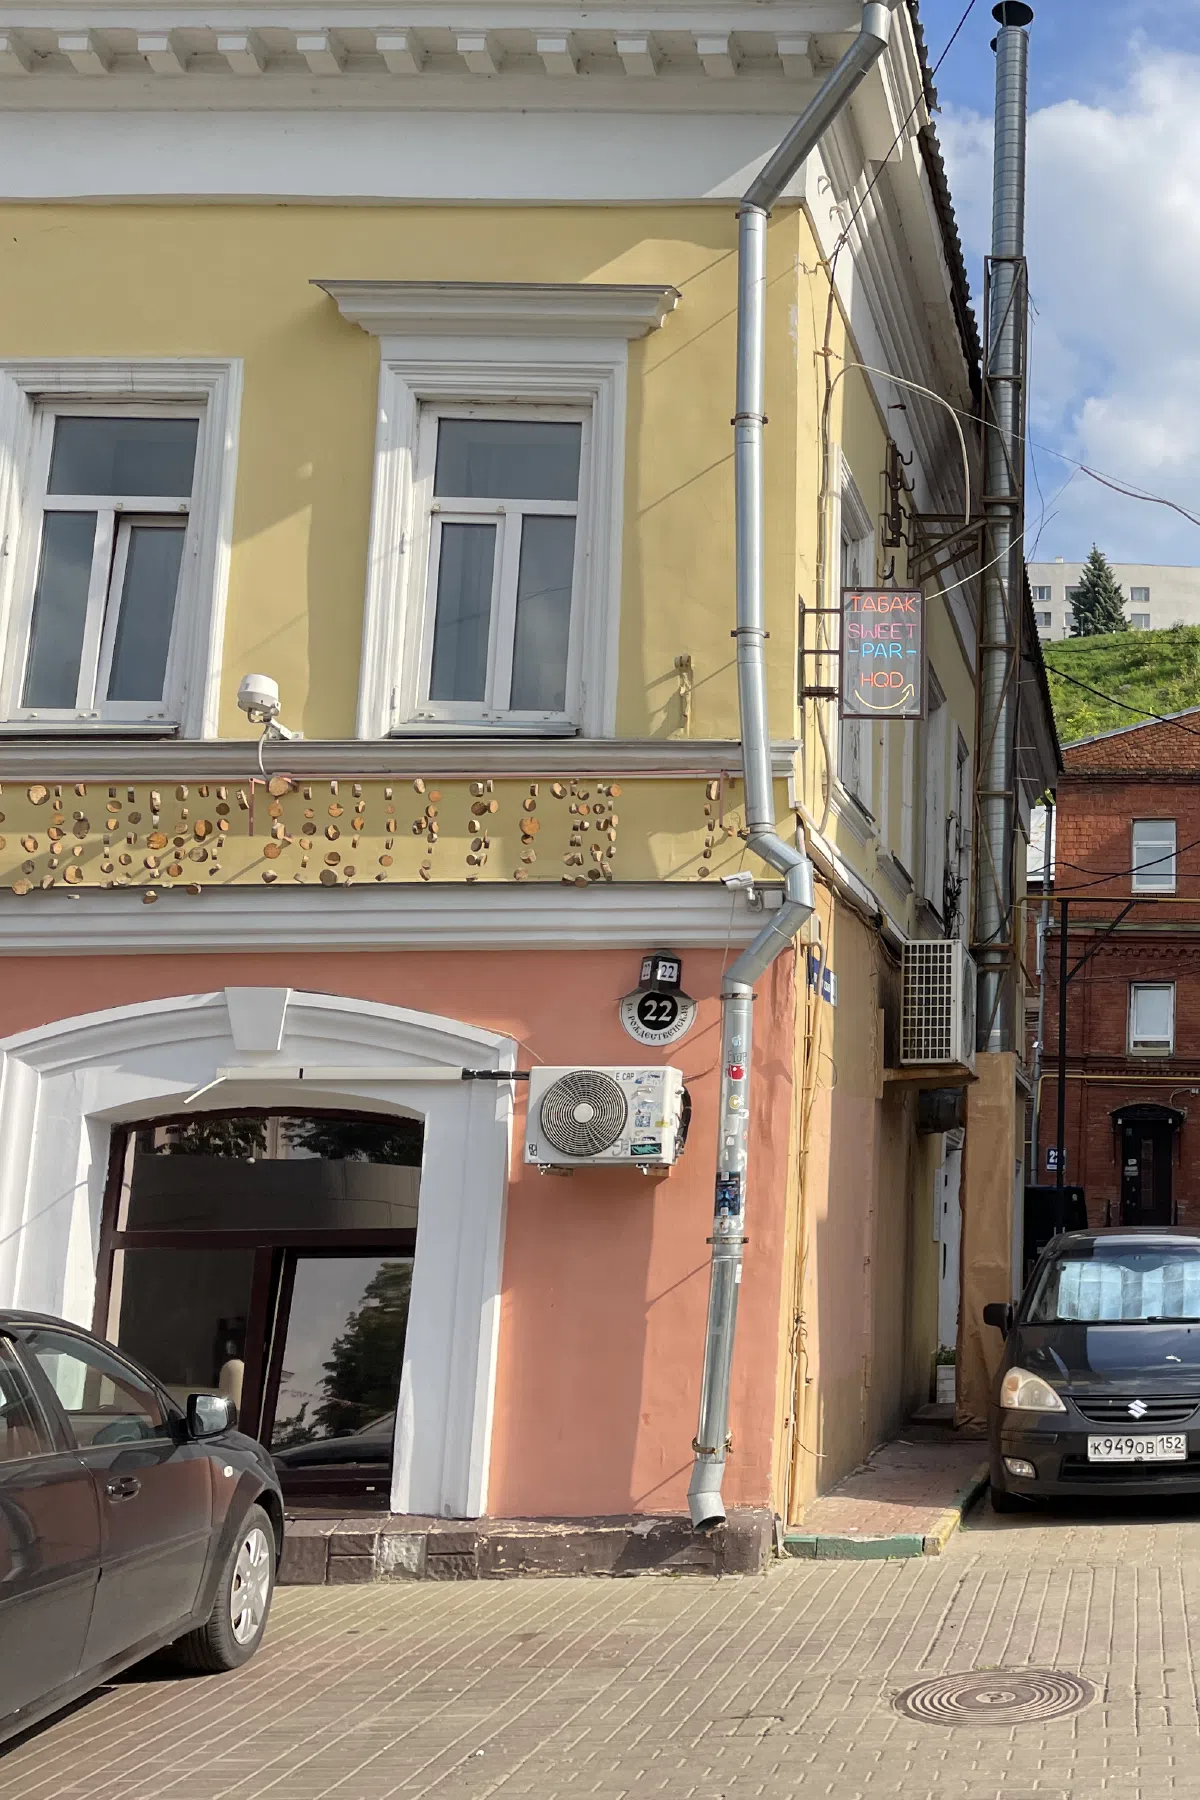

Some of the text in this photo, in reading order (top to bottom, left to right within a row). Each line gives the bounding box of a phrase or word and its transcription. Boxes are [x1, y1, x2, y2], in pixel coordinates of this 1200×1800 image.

[851, 596, 916, 613] ТАБАК
[848, 623, 917, 639] SWEET
[860, 671, 904, 688] HQD
[661, 964, 675, 979] 22
[643, 999, 673, 1022] 22
[1159, 1436, 1182, 1450] 152
